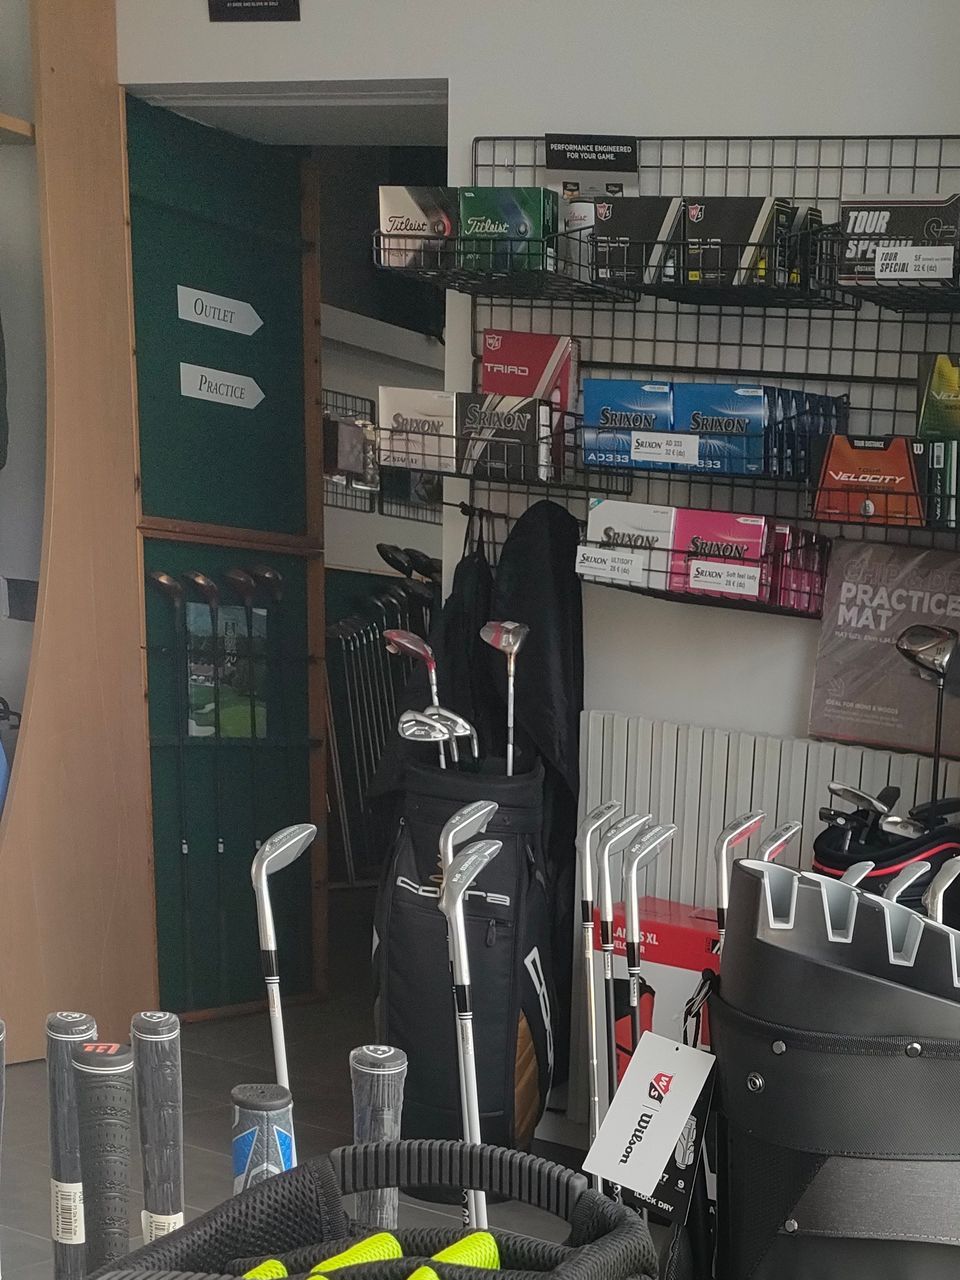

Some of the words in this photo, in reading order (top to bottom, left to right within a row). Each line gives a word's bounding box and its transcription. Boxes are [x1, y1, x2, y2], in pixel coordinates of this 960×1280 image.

[386, 215, 428, 233] Titleist
[465, 216, 509, 235] Titleist
[847, 211, 890, 233] TOUR
[880, 252, 898, 261] TOUR
[879, 262, 909, 273] SPECIAL
[484, 362, 528, 376] TRIAD
[392, 412, 444, 437] SRIXON
[463, 403, 532, 434] SRIXON
[600, 406, 657, 429] SRIXON
[690, 410, 750, 433] SRIXON
[634, 438, 662, 449] SRIXON
[587, 452, 629, 463] AD333
[828, 470, 905, 484] VELOCITY
[602, 526, 659, 547] SRIXON
[690, 535, 748, 558] SRIXON
[579, 553, 607, 565] SRIXON
[693, 567, 722, 579] SRIXON
[840, 582, 960, 618] PRACTICE
[837, 604, 893, 631] MAT
[646, 932, 659, 945] XL
[618, 1112, 654, 1166] Wilson
[677, 1179, 685, 1188] 9
[657, 1201, 674, 1213] DRY
